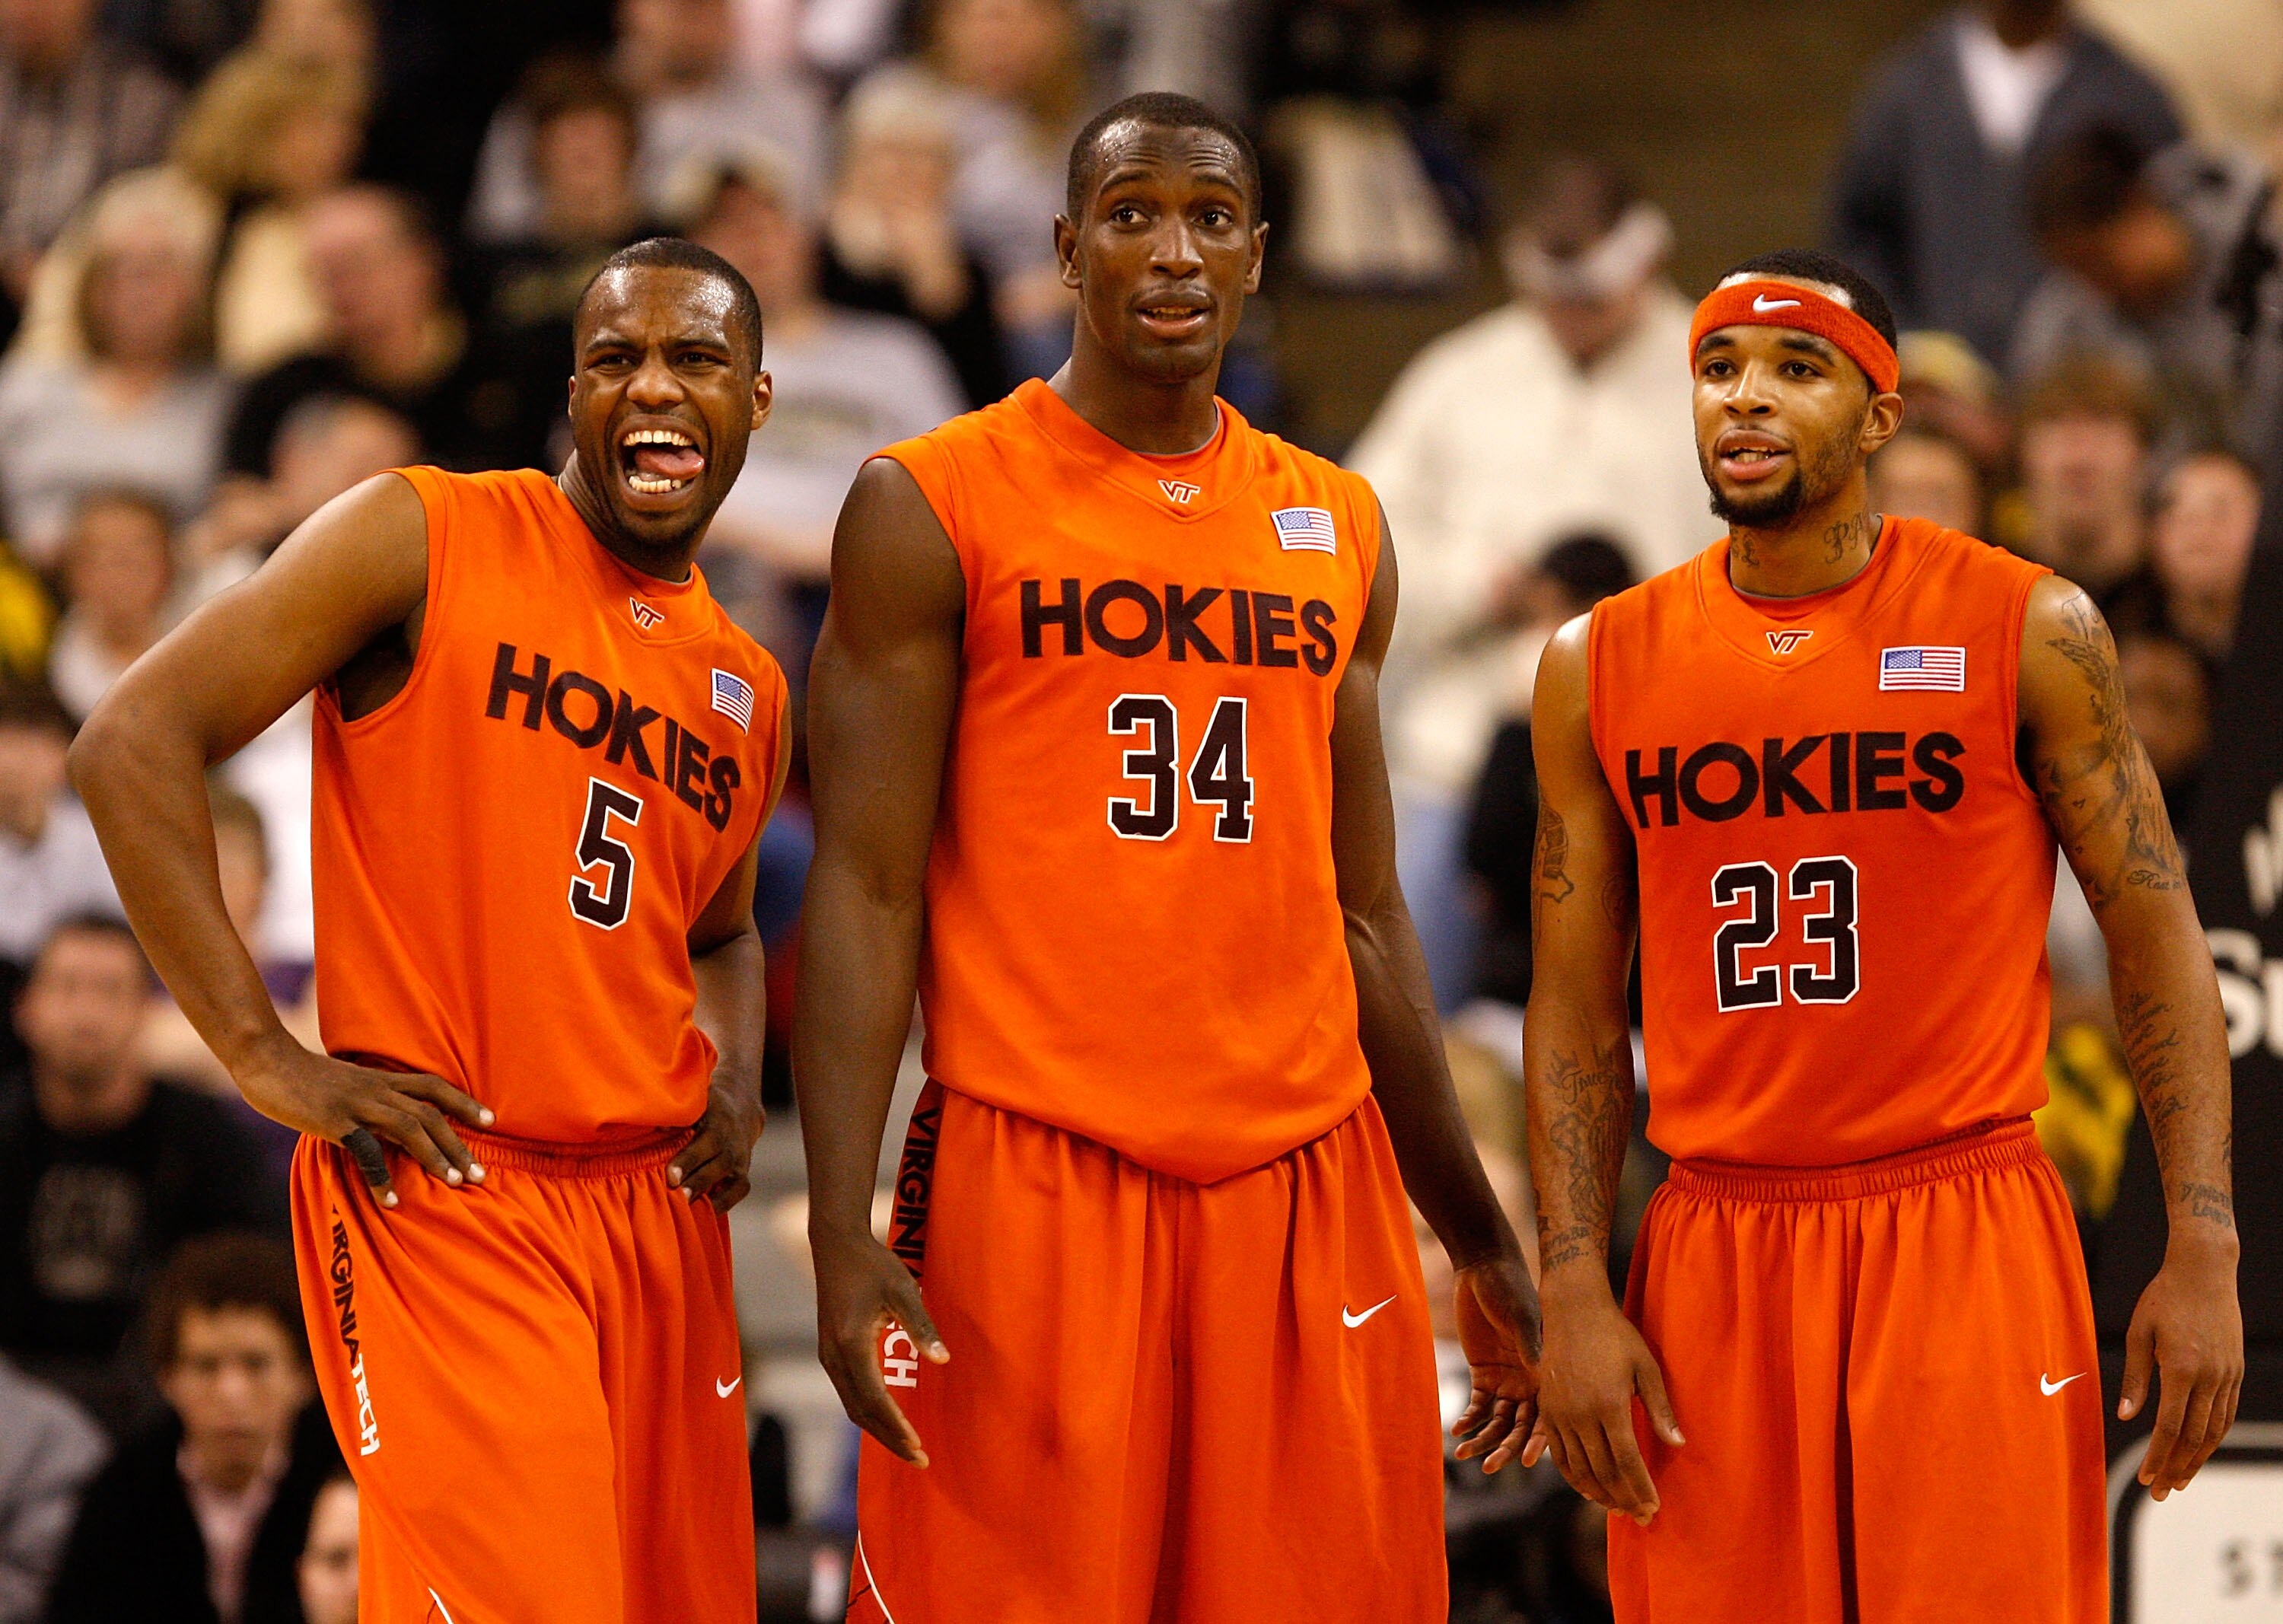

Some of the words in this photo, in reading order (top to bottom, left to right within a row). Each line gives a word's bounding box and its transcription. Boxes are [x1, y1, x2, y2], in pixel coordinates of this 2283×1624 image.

[1157, 479, 1201, 504] VT
[629, 597, 665, 630] VT
[1021, 578, 1337, 677] HOKIES
[1766, 630, 1813, 655] VT
[486, 642, 741, 833] HOKIES
[1107, 693, 1254, 843] 34
[1625, 731, 1966, 829] HOKIES
[568, 776, 644, 931] 5
[1711, 855, 1859, 1012] 23
[330, 1202, 359, 1369] IRGINIA
[351, 1352, 380, 1457] TECH
